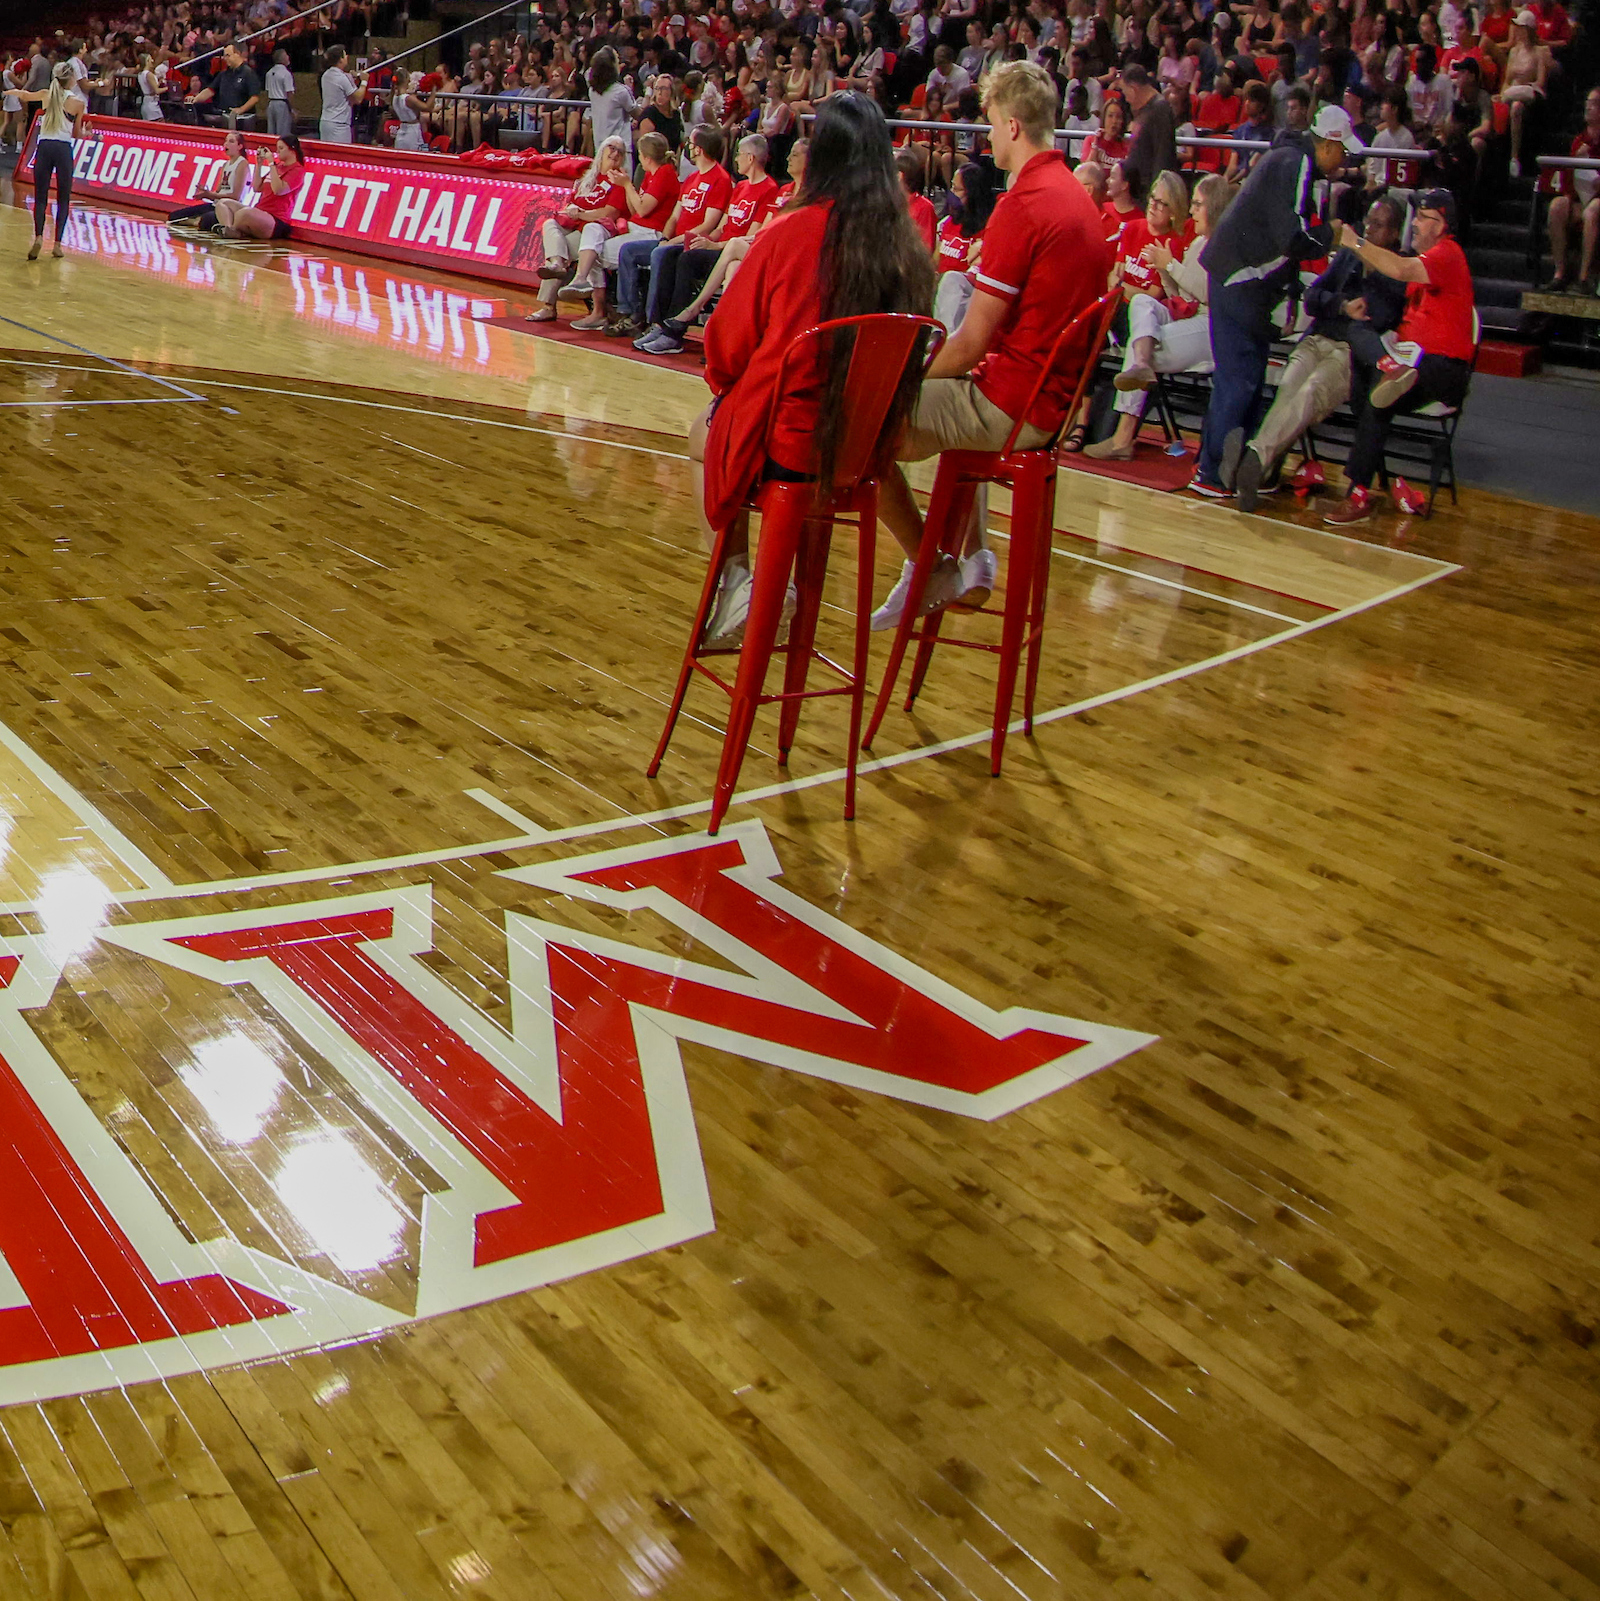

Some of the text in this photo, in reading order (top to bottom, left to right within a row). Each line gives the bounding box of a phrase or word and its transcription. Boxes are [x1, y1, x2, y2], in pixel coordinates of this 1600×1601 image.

[1396, 162, 1408, 183] 5
[1550, 170, 1562, 192] 4
[388, 187, 502, 256] HALL
